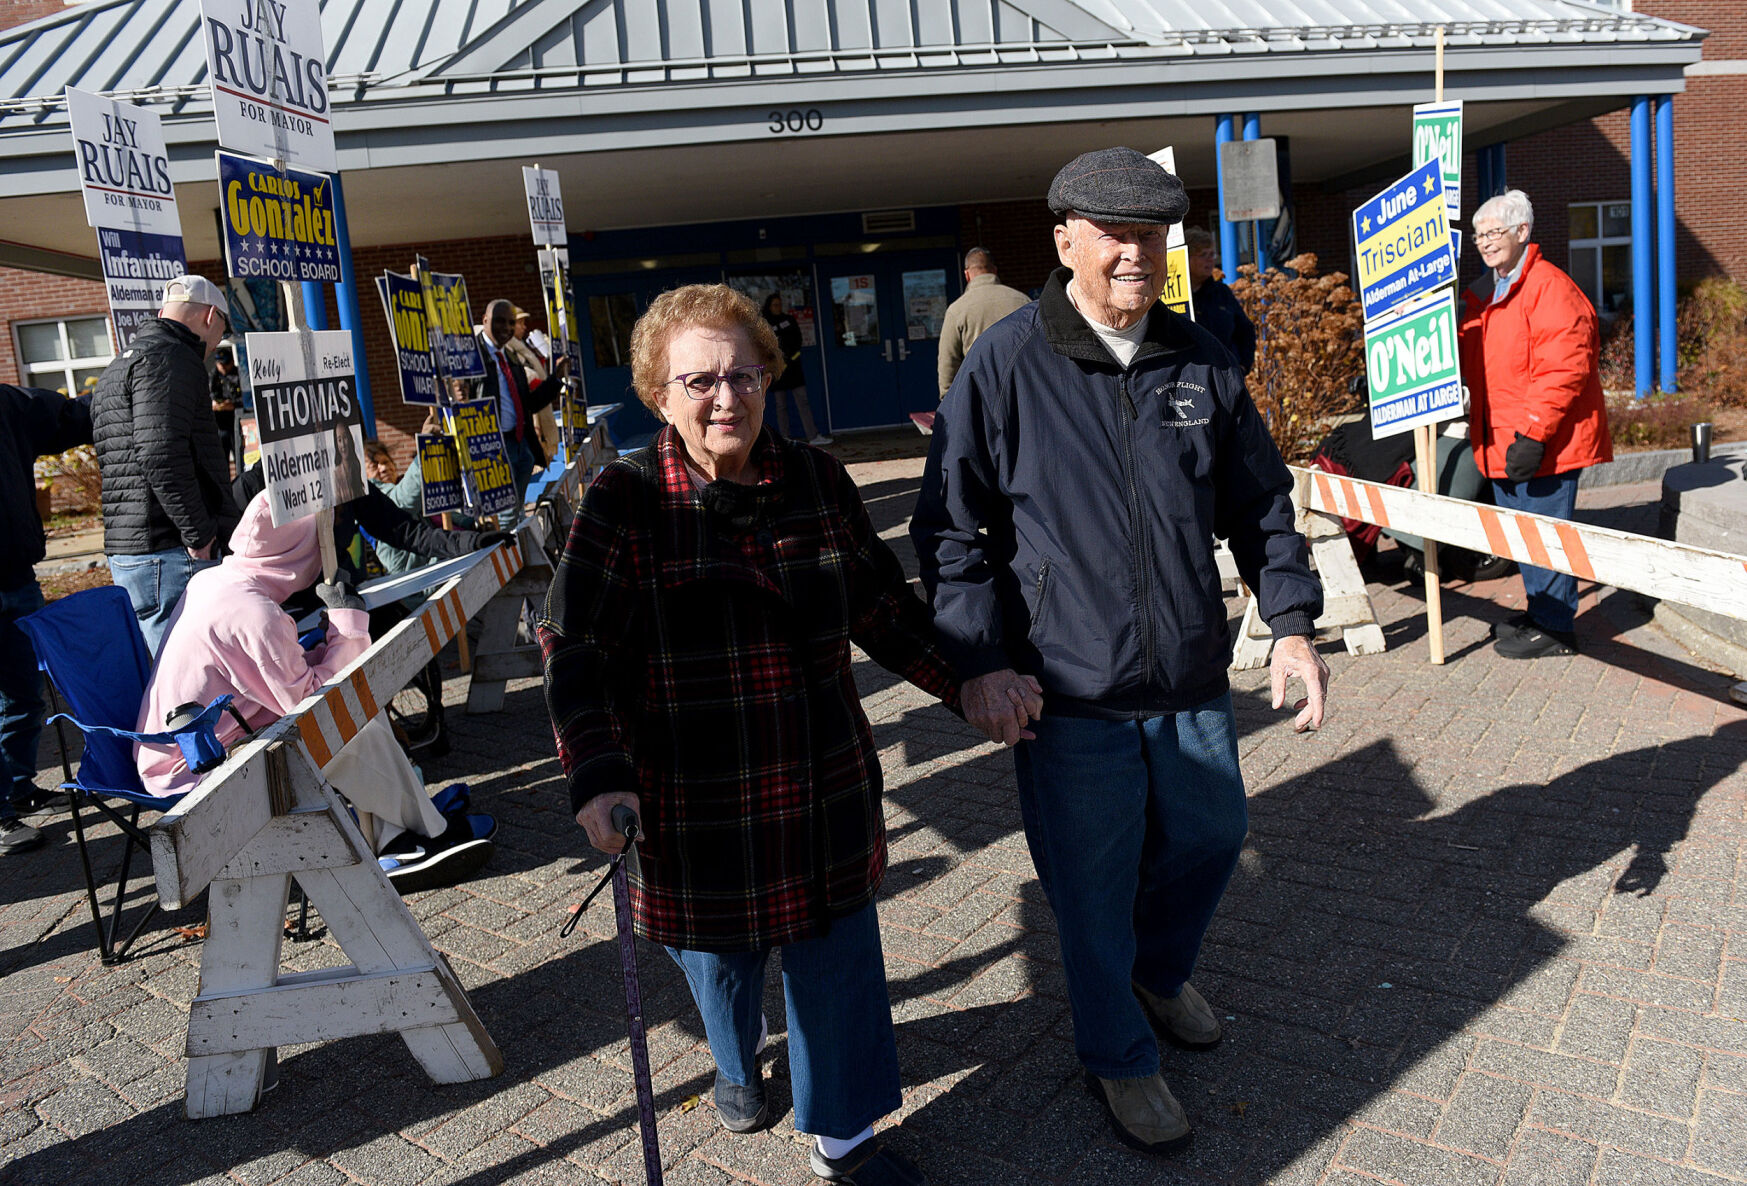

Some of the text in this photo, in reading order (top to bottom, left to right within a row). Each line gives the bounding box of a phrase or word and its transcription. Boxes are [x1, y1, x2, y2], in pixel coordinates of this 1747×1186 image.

[241, 0, 286, 44] JAY
[207, 16, 327, 114] RUAIS
[102, 113, 138, 149] JAY
[240, 101, 314, 136] FOR MAYOR
[768, 109, 823, 134] 300
[1415, 121, 1459, 174] O'Neil
[77, 139, 172, 194] RUAIS
[248, 172, 301, 200] CARLOS
[104, 193, 162, 212] FOR MAYOR
[227, 180, 336, 246] Gonzalez
[529, 196, 563, 221] RUAIS
[1376, 185, 1418, 225] June
[101, 230, 121, 248] Will
[1361, 205, 1444, 276] Trisciani
[104, 249, 185, 279] Infantine
[237, 257, 338, 280] SCHOOL BOARD
[110, 284, 154, 304] Alderman
[1365, 276, 1407, 308] Alderman
[1407, 253, 1450, 285] At-Large
[399, 289, 423, 310] CARL
[117, 311, 132, 327] Joe
[391, 293, 430, 352] Gonz
[400, 351, 432, 373] SCHOOL
[1370, 311, 1454, 393] O'Neil
[253, 356, 351, 382] Kelly Re-Elect
[413, 375, 436, 395] WAR
[1176, 381, 1206, 394] FLIGHT
[261, 380, 352, 432] THOMAS
[1373, 384, 1459, 425] ALDERMAN AT LARGE
[1174, 418, 1210, 427] ENGLAND
[267, 448, 330, 484] Alderman
[473, 460, 512, 492] nzalez
[281, 480, 323, 510] Ward 12
